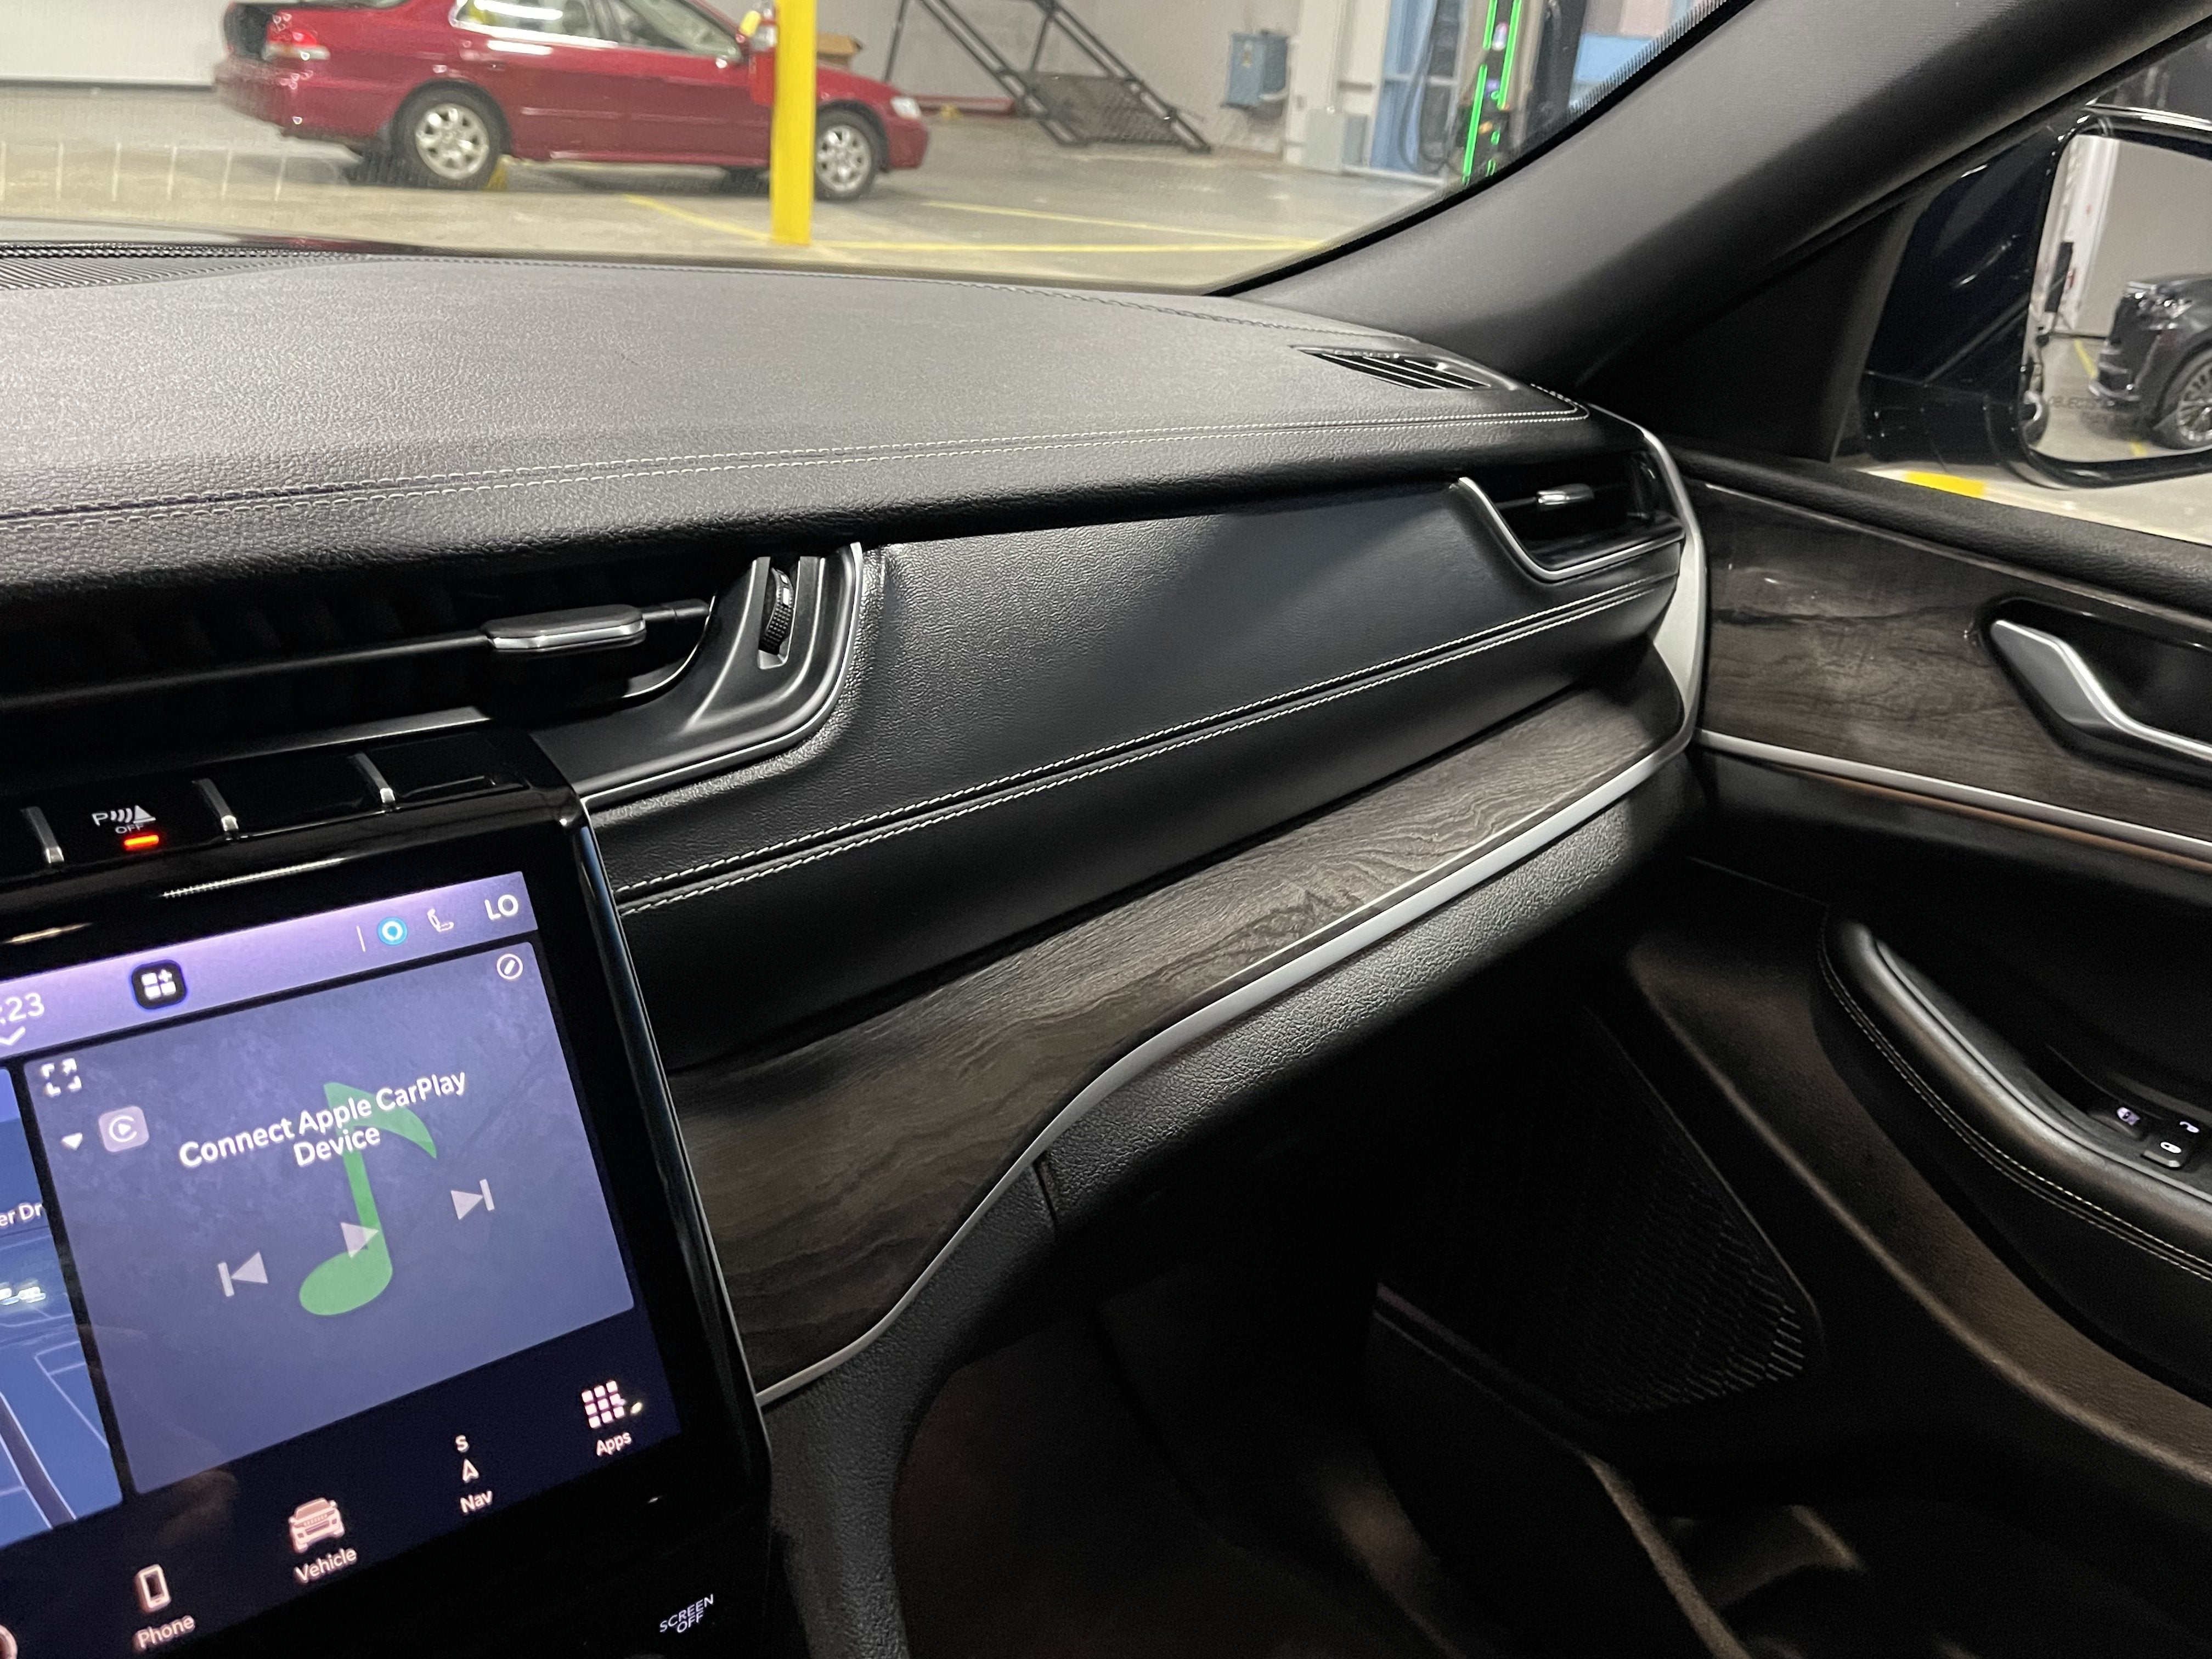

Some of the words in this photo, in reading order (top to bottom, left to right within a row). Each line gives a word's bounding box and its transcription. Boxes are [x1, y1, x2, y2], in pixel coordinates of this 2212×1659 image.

[115, 823, 144, 834] OFF
[484, 894, 518, 921] LO
[179, 1118, 295, 1167] Connect
[298, 1096, 372, 1135] Apple
[375, 1071, 466, 1111] CarPlay
[293, 1126, 381, 1167] Device
[19, 1202, 43, 1221] Dr
[596, 1431, 632, 1456] Apps
[460, 1489, 493, 1514] Nav
[294, 1547, 358, 1584] Vehicle
[659, 1593, 714, 1633] SCREEN
[677, 1610, 704, 1633] OFF
[135, 1615, 195, 1651] Phone
